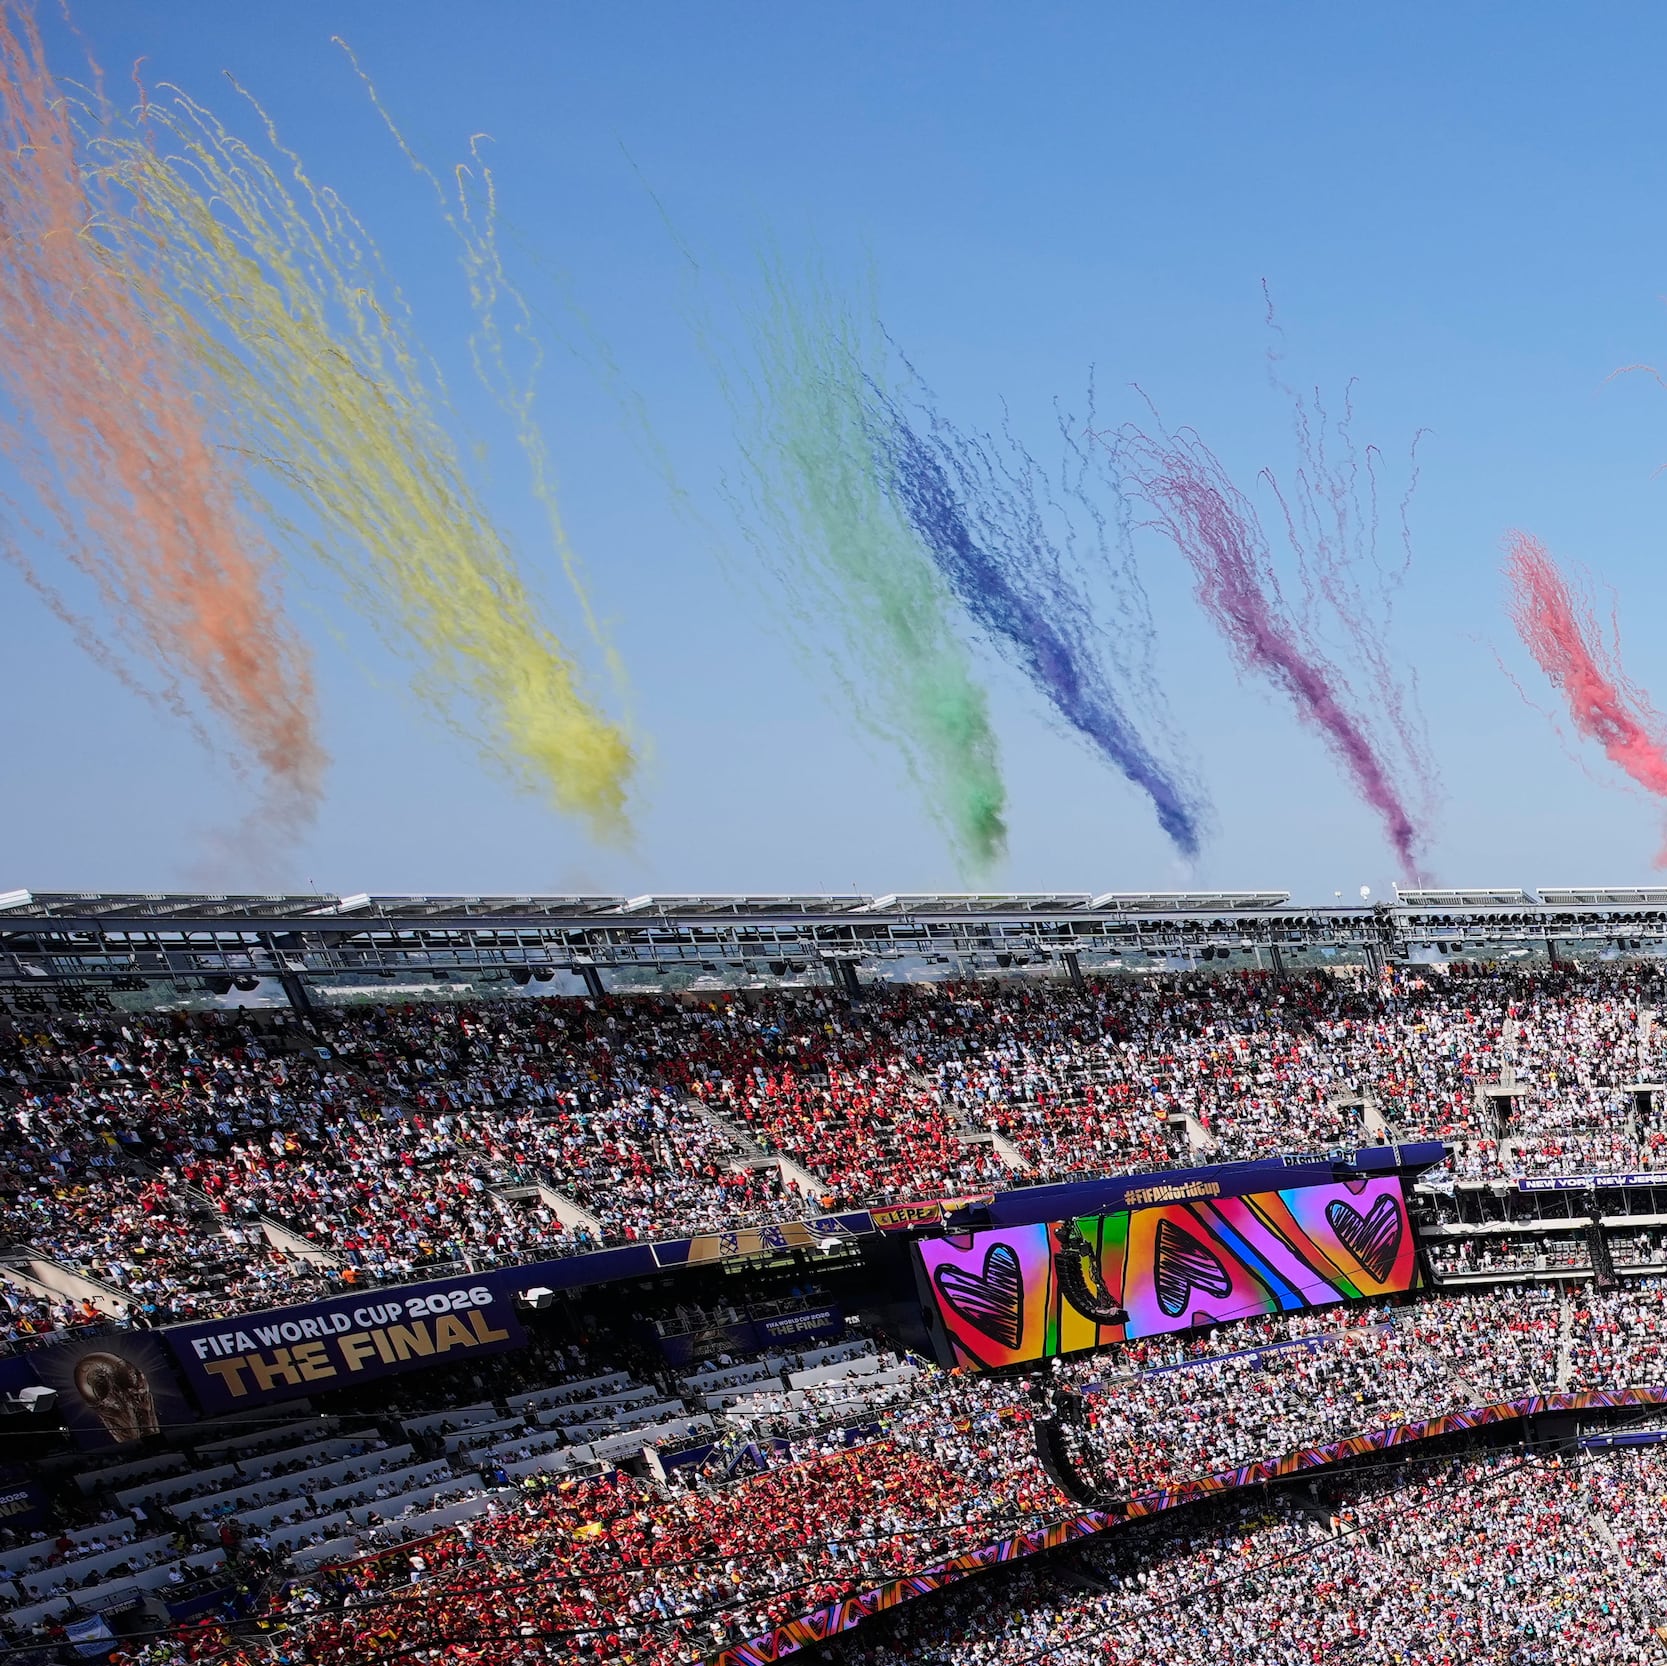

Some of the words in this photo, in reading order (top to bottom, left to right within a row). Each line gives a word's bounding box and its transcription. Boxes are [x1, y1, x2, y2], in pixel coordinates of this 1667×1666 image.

[1526, 1178, 1552, 1189] NEW
[1596, 1176, 1626, 1186] NEW
[1124, 1181, 1220, 1206] #FIFAWorldCup
[888, 1207, 924, 1223] LEPE
[191, 1329, 255, 1359] FIFA
[250, 1312, 351, 1347] WORLD
[353, 1302, 402, 1328] CUP
[404, 1286, 494, 1318] 2026
[766, 1321, 780, 1329] FIFA
[780, 1317, 800, 1327] WORLD
[801, 1315, 811, 1323] CUP
[768, 1325, 797, 1337] THE
[799, 1318, 833, 1333] FINAL
[203, 1340, 337, 1397] THE
[337, 1309, 510, 1371] FINAL
